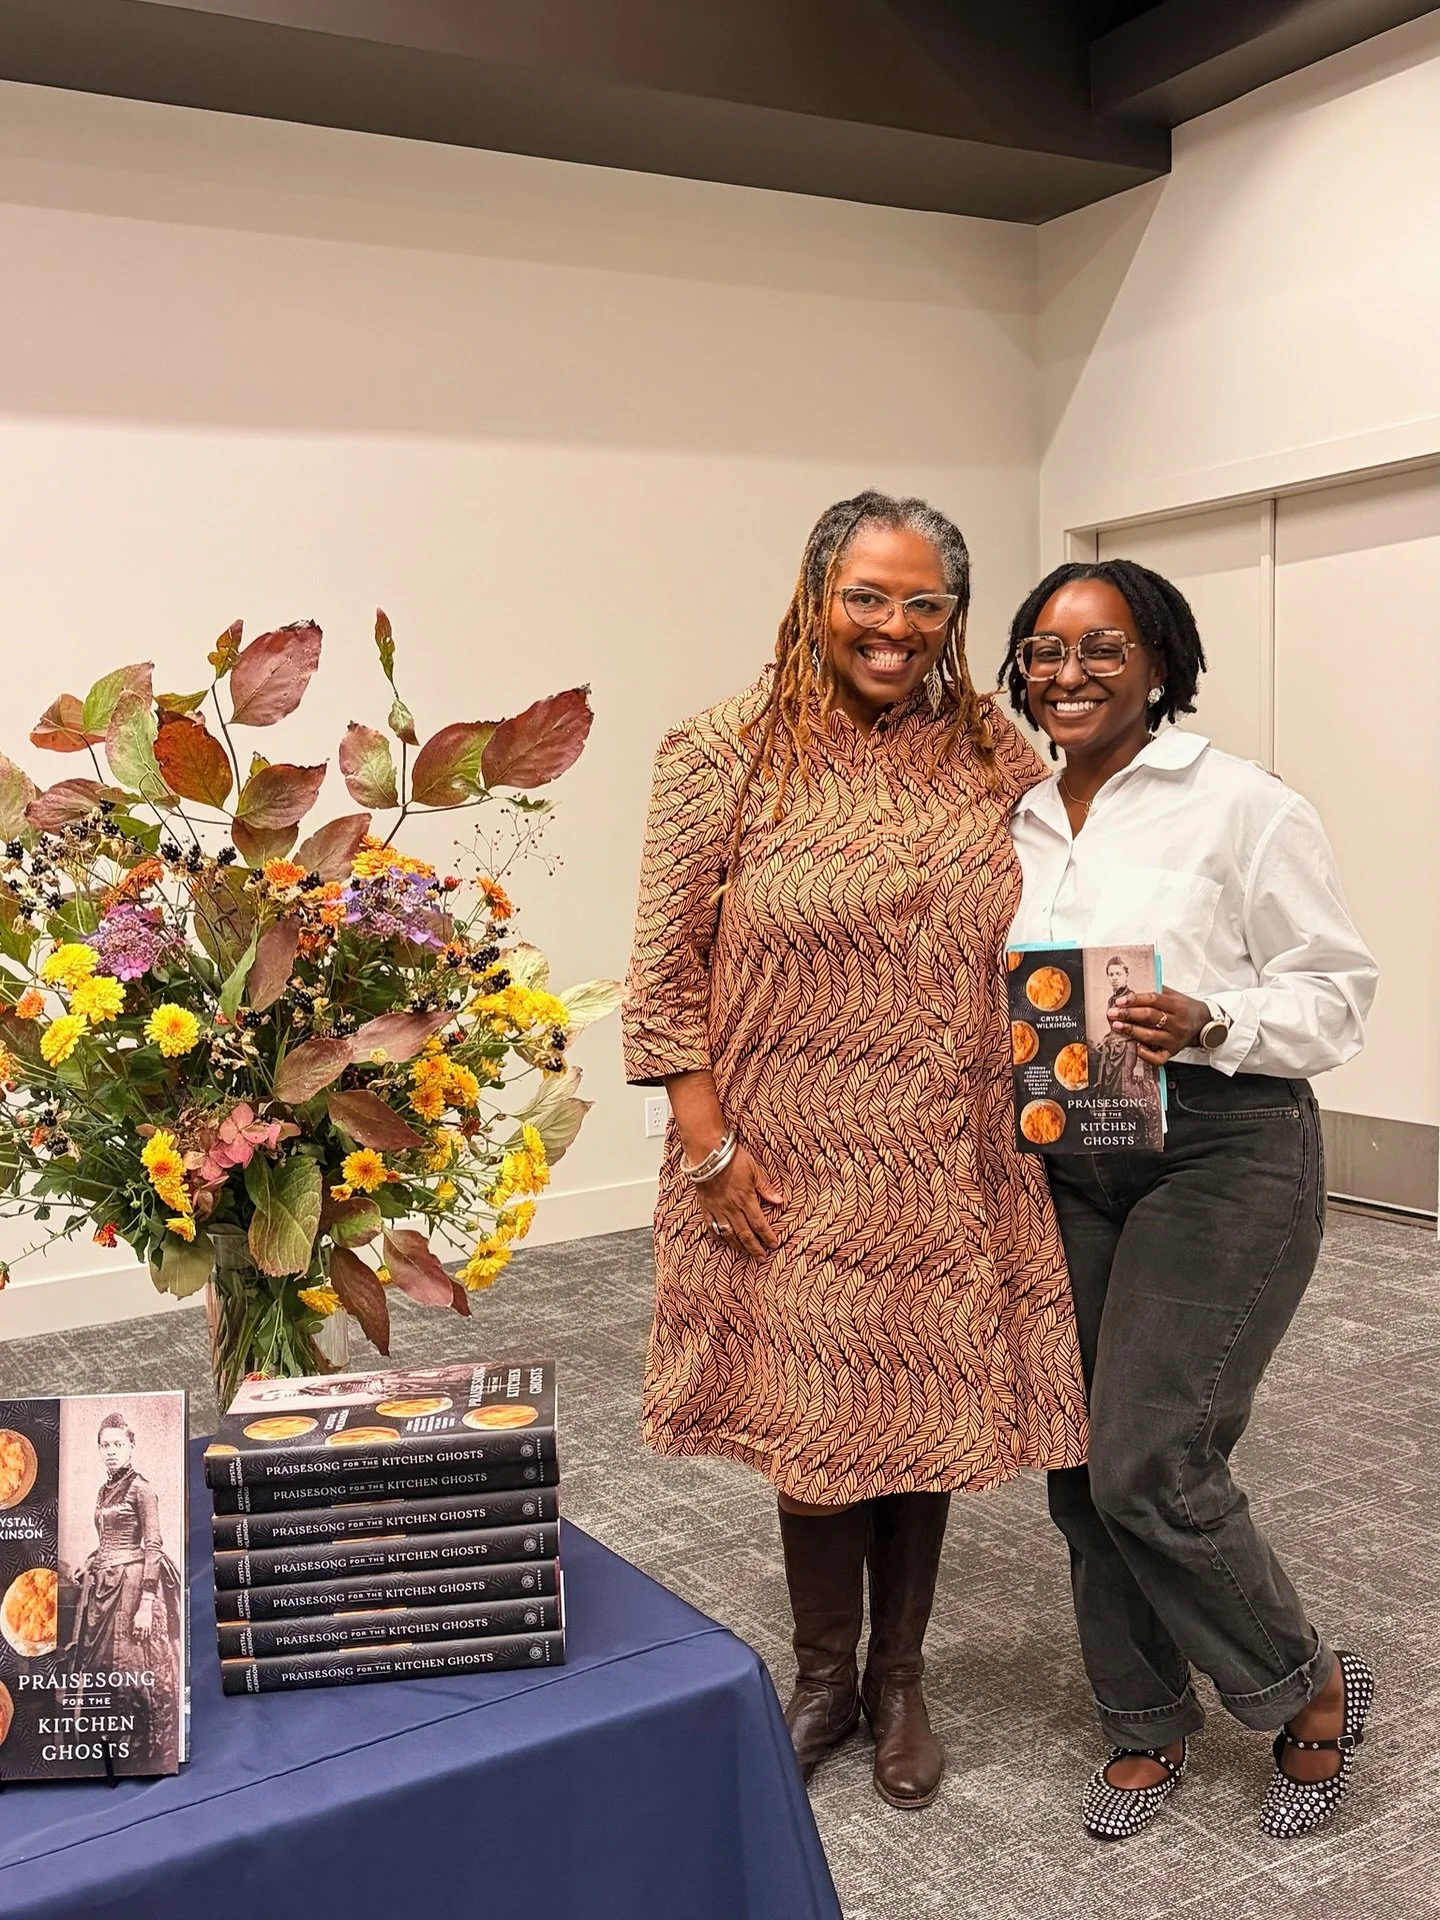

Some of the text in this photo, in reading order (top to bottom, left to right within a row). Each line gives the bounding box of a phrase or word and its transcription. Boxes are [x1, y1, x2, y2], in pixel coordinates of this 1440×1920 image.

[1068, 1099, 1147, 1109] PRAISESONG
[1080, 1122, 1137, 1131] KITCHEN
[1083, 1136, 1134, 1146] GHOSTS
[266, 1462, 340, 1476] PRAISESONG
[343, 1460, 360, 1468] FOR
[382, 1454, 433, 1466] KITCHEN
[437, 1449, 484, 1462] GHOSTS
[274, 1486, 346, 1500] PRAISESONG
[388, 1477, 438, 1490] KITCHEN
[441, 1473, 487, 1485] GHOSTS
[0, 1517, 35, 1528] YSTAL
[272, 1522, 345, 1537] PRAISESONG
[386, 1513, 437, 1526] KITCHEN
[440, 1509, 486, 1521] GHOSTS
[0, 1529, 43, 1540] KINSON
[274, 1559, 346, 1573] PRAISESONG
[388, 1549, 438, 1563] KITCHEN
[441, 1545, 487, 1558] GHOSTS
[273, 1594, 345, 1608] PRAISESONG
[386, 1585, 436, 1598] KITCHEN
[439, 1581, 486, 1594] GHOSTS
[276, 1631, 348, 1646] PRAISESONG
[388, 1622, 439, 1636] KITCHEN
[442, 1618, 488, 1632] GHOSTS
[282, 1667, 354, 1682] PRAISESONG
[394, 1658, 445, 1671] KITCHEN
[448, 1653, 494, 1666] GHOSTS
[18, 1670, 156, 1690] PRAISESONG
[62, 1697, 111, 1706] FOR THE
[38, 1716, 135, 1734] KITCHEN
[42, 1742, 130, 1760] GHOSTS
